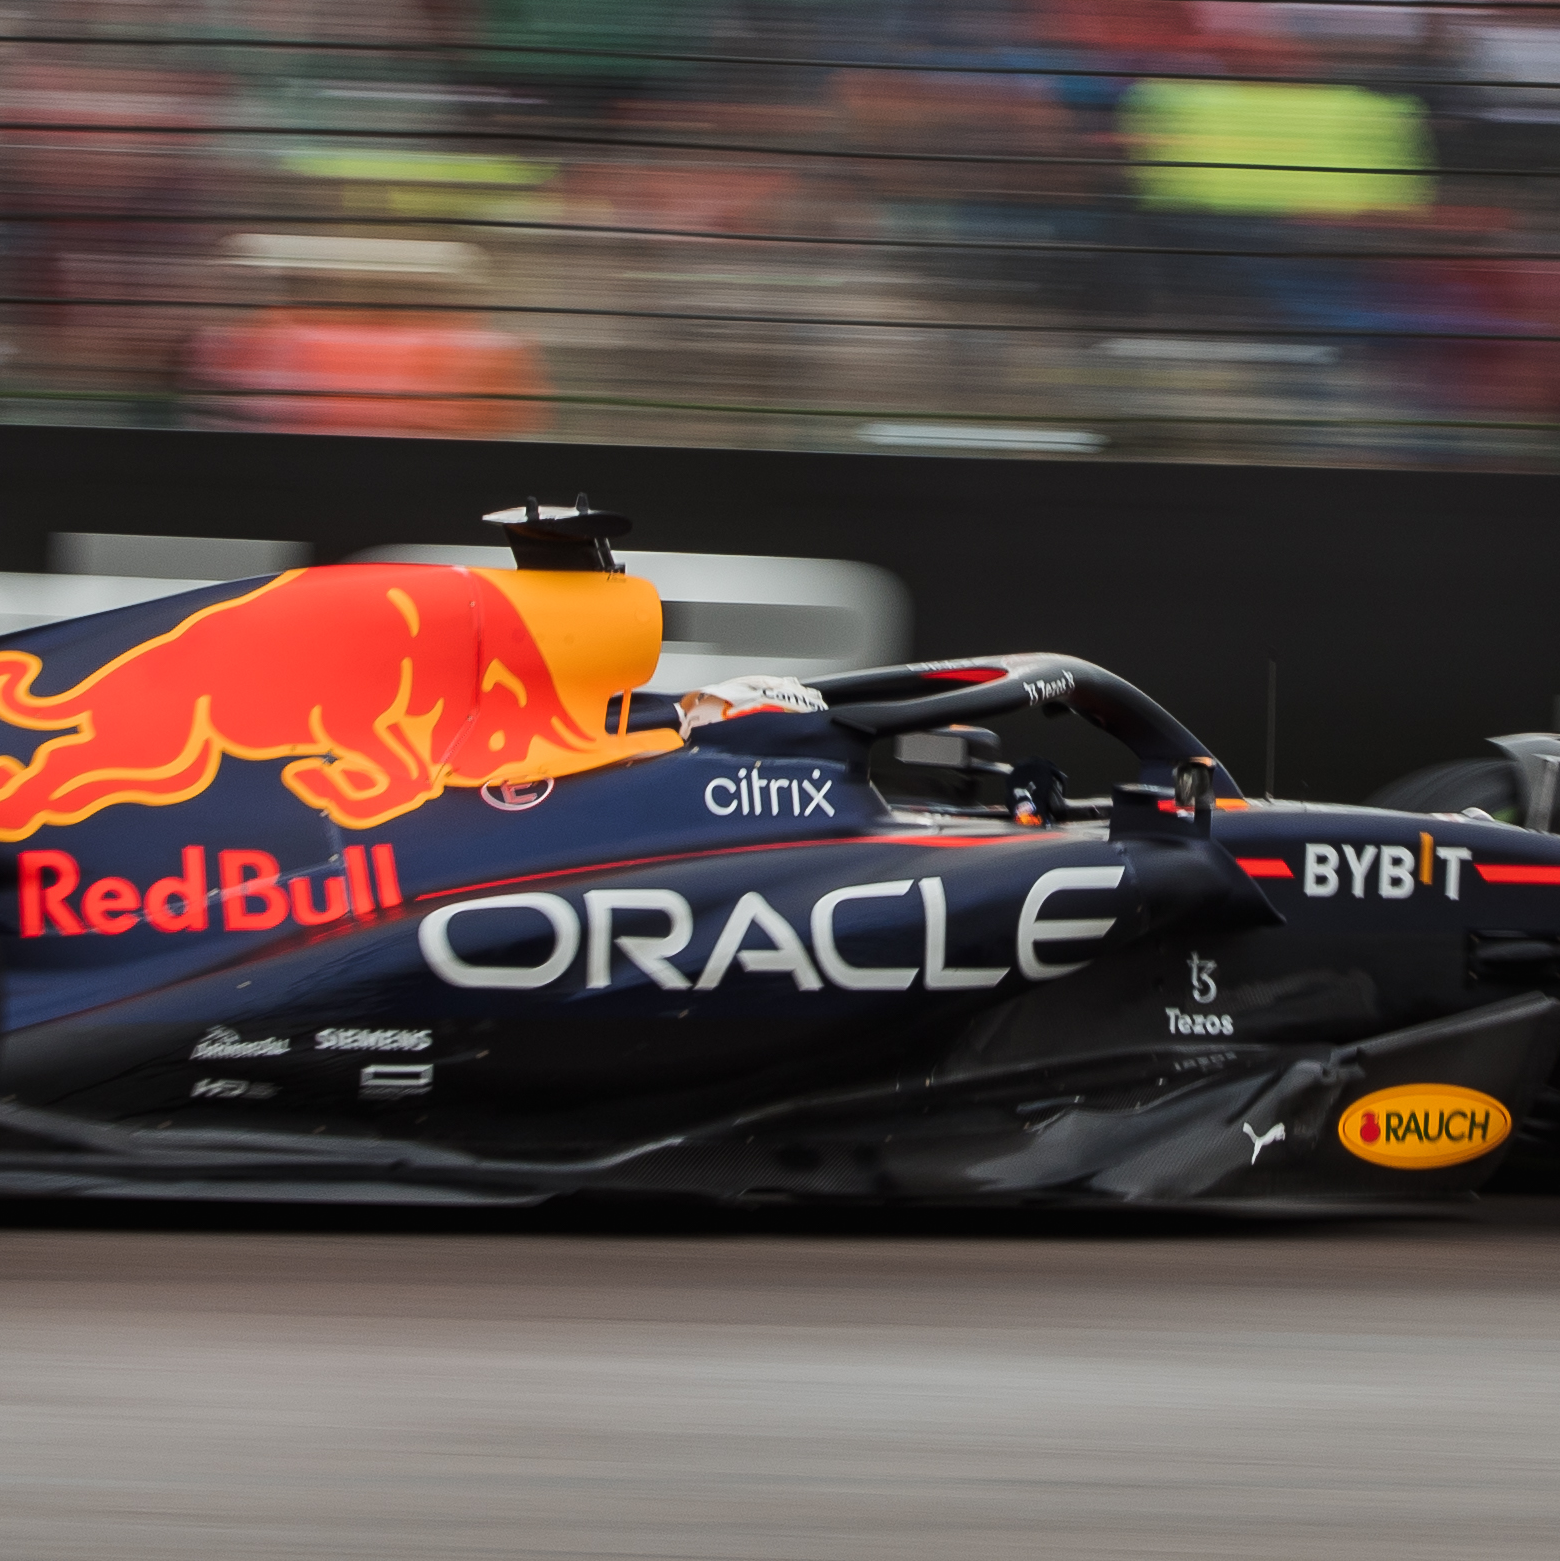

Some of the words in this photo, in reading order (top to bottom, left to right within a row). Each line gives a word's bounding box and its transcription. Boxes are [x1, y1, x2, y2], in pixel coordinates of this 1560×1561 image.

[704, 768, 835, 817] citrix
[18, 846, 208, 937] Red
[221, 844, 402, 931] Bull
[1304, 831, 1473, 901] BYBIT
[418, 865, 1125, 991] ORACLE
[1165, 1007, 1234, 1035] Tezos
[1385, 1109, 1490, 1144] RAUCH
